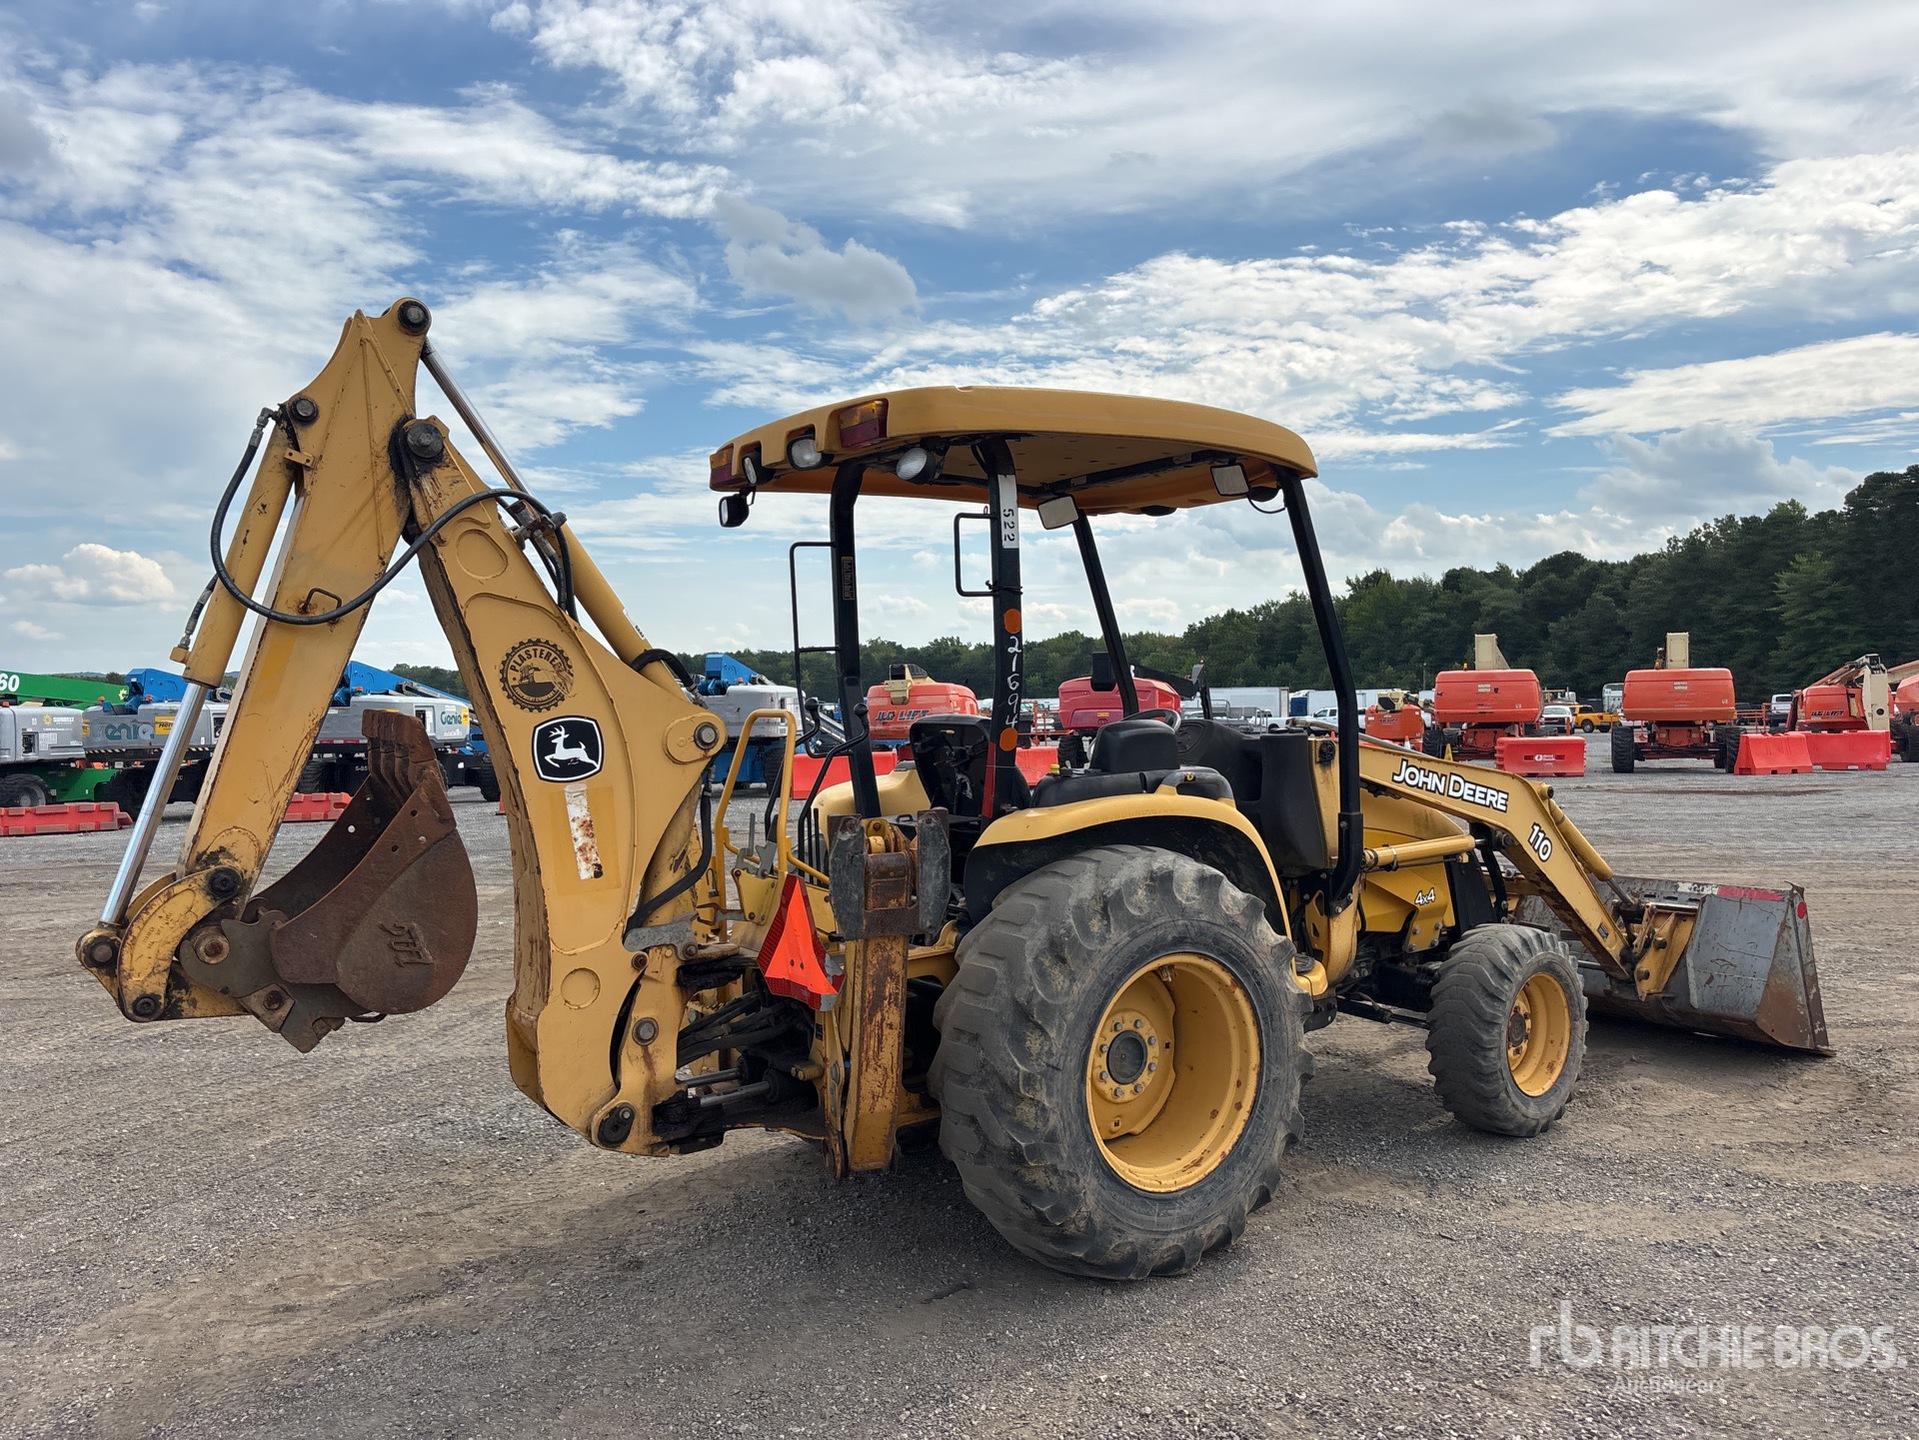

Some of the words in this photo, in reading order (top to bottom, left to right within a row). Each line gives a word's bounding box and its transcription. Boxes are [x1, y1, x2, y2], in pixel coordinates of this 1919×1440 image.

[1003, 508, 1016, 542] 522
[1006, 635, 1022, 730] 21694
[440, 711, 462, 725] Genie
[1392, 759, 1446, 795] JOHN
[1447, 772, 1510, 813] DEERE
[1527, 822, 1553, 863] 110
[1414, 887, 1437, 907] 4x4
